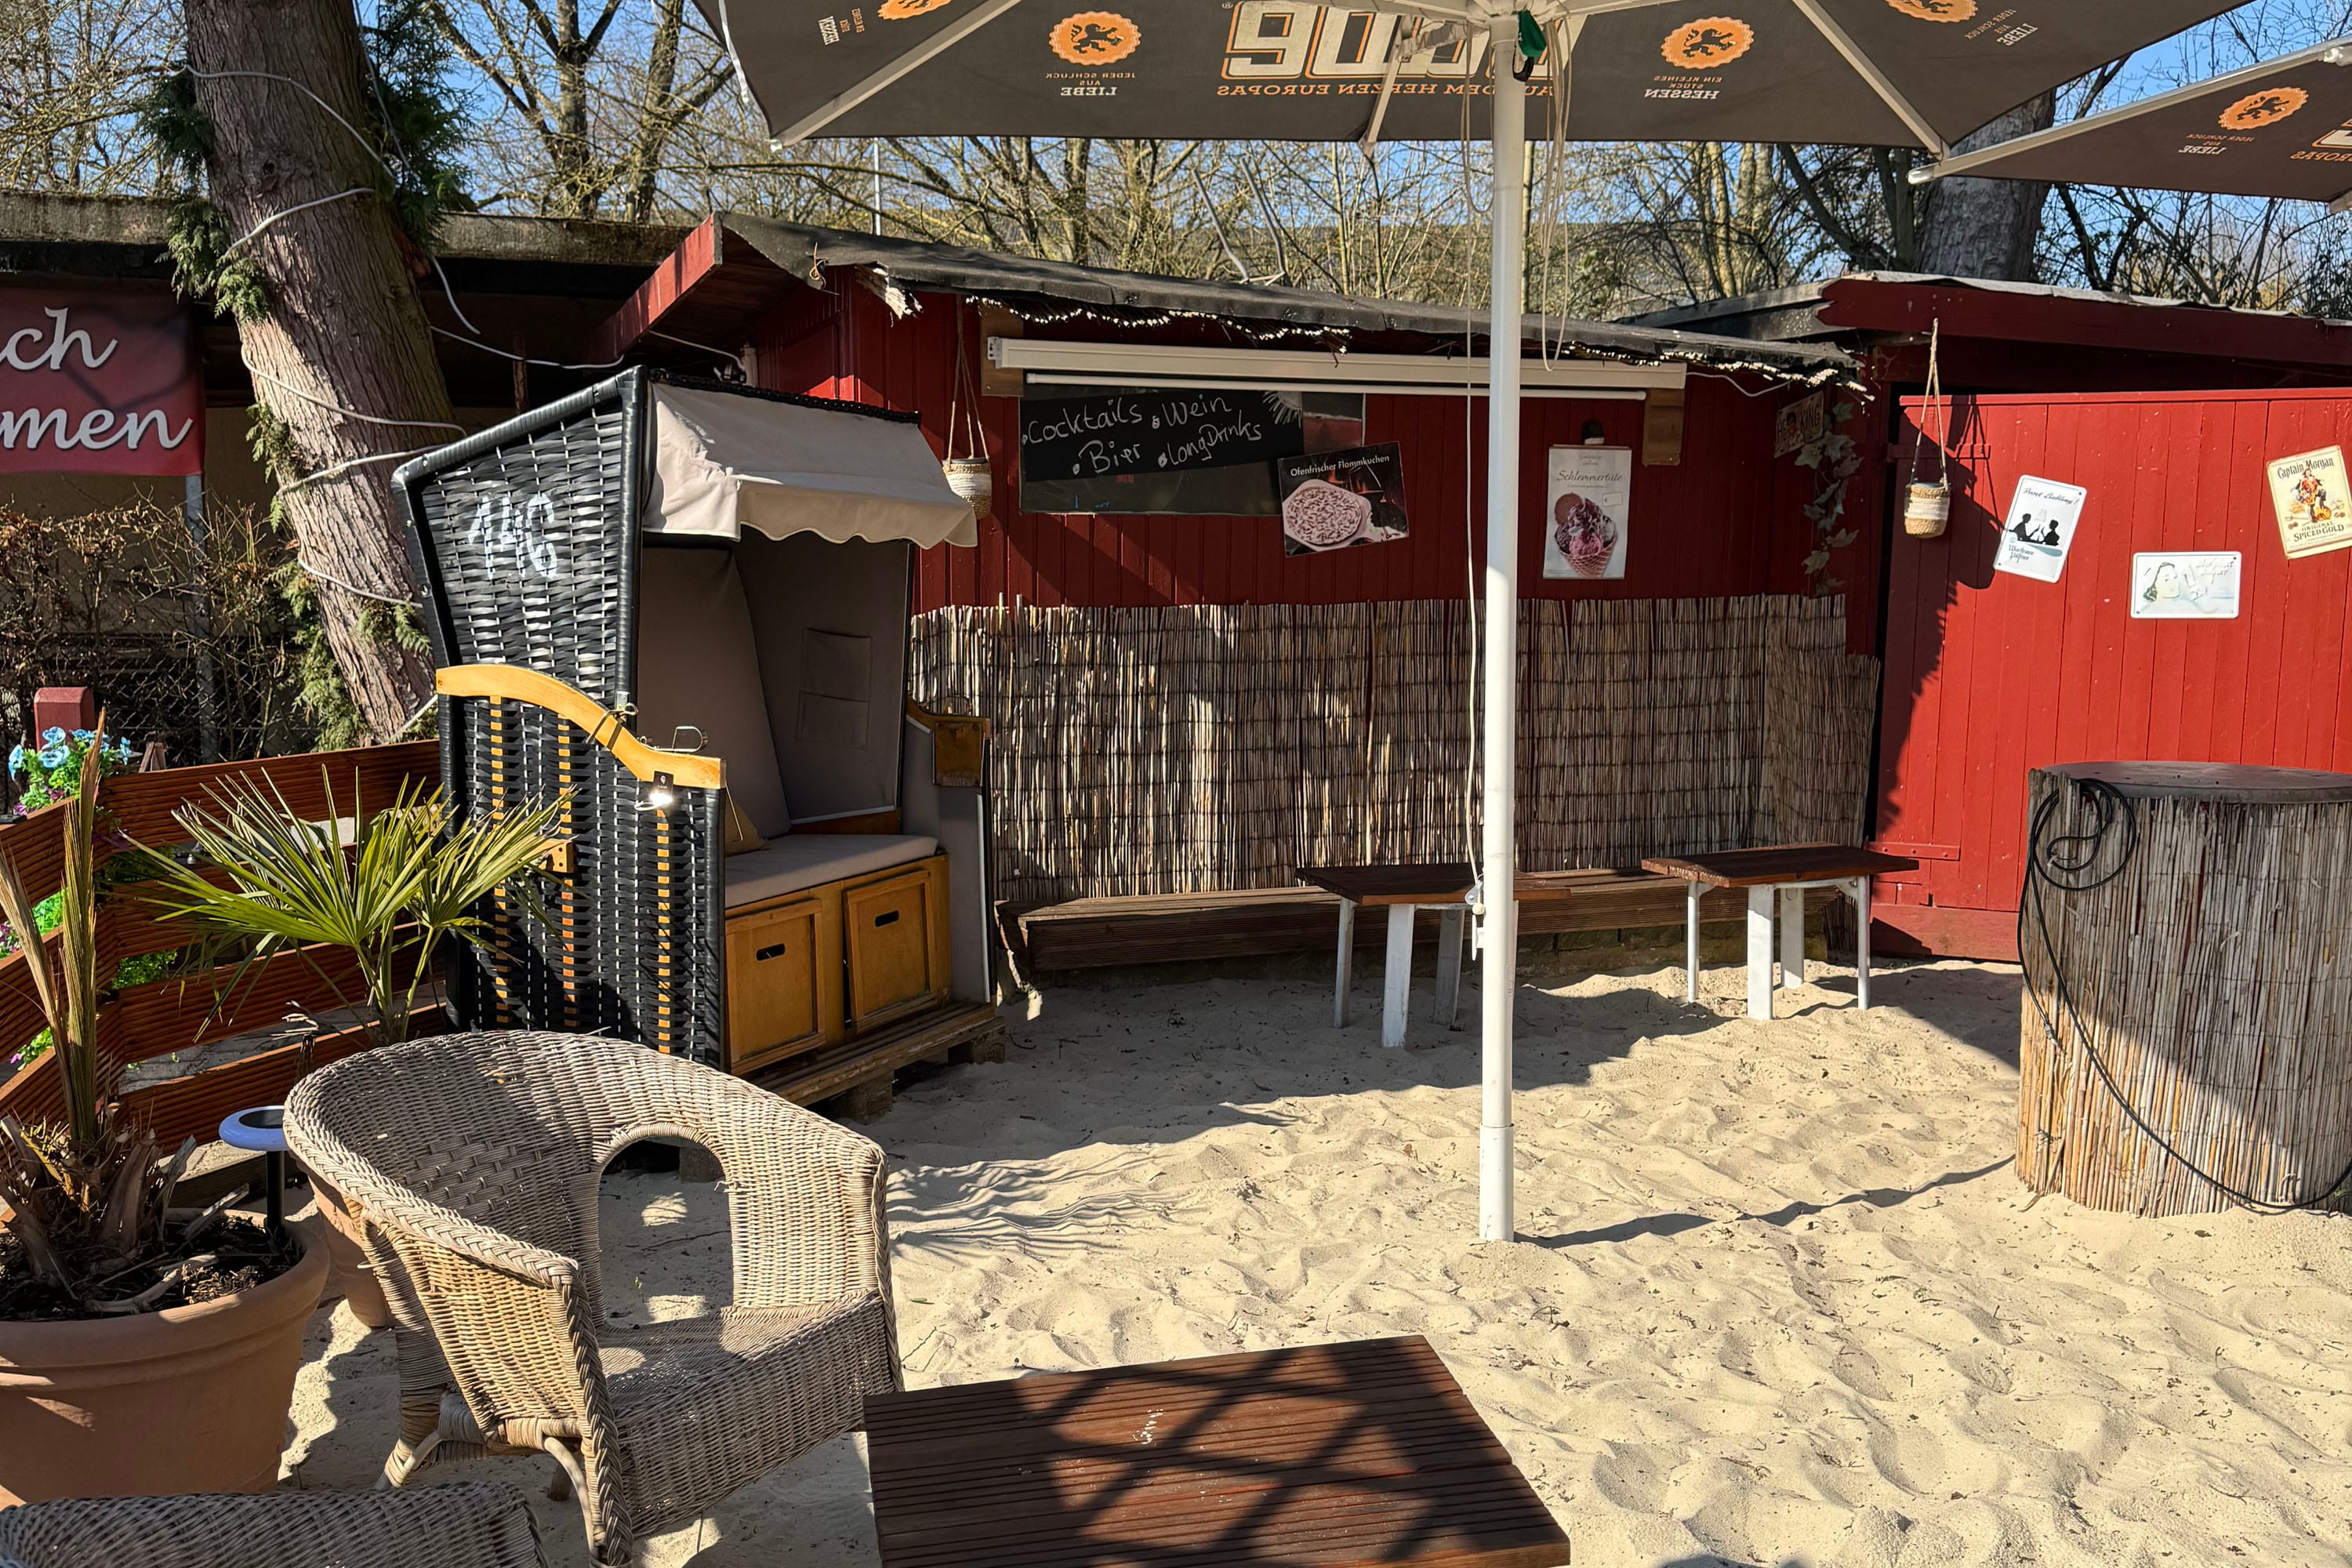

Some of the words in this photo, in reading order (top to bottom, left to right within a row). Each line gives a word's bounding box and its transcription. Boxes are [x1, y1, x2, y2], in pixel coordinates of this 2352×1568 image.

[1028, 397, 1143, 444] Cocktails
[1162, 394, 1232, 426] Wein
[1079, 440, 1141, 474] Bier
[1290, 463, 1337, 477] Ofenfrischer
[1338, 455, 1390, 470] Flammkuchen
[2277, 462, 2304, 480] Captain
[2304, 457, 2335, 470] Morgan
[467, 492, 557, 579] 146
[2293, 529, 2321, 543] SPICED
[2321, 524, 2345, 535] GOLD
